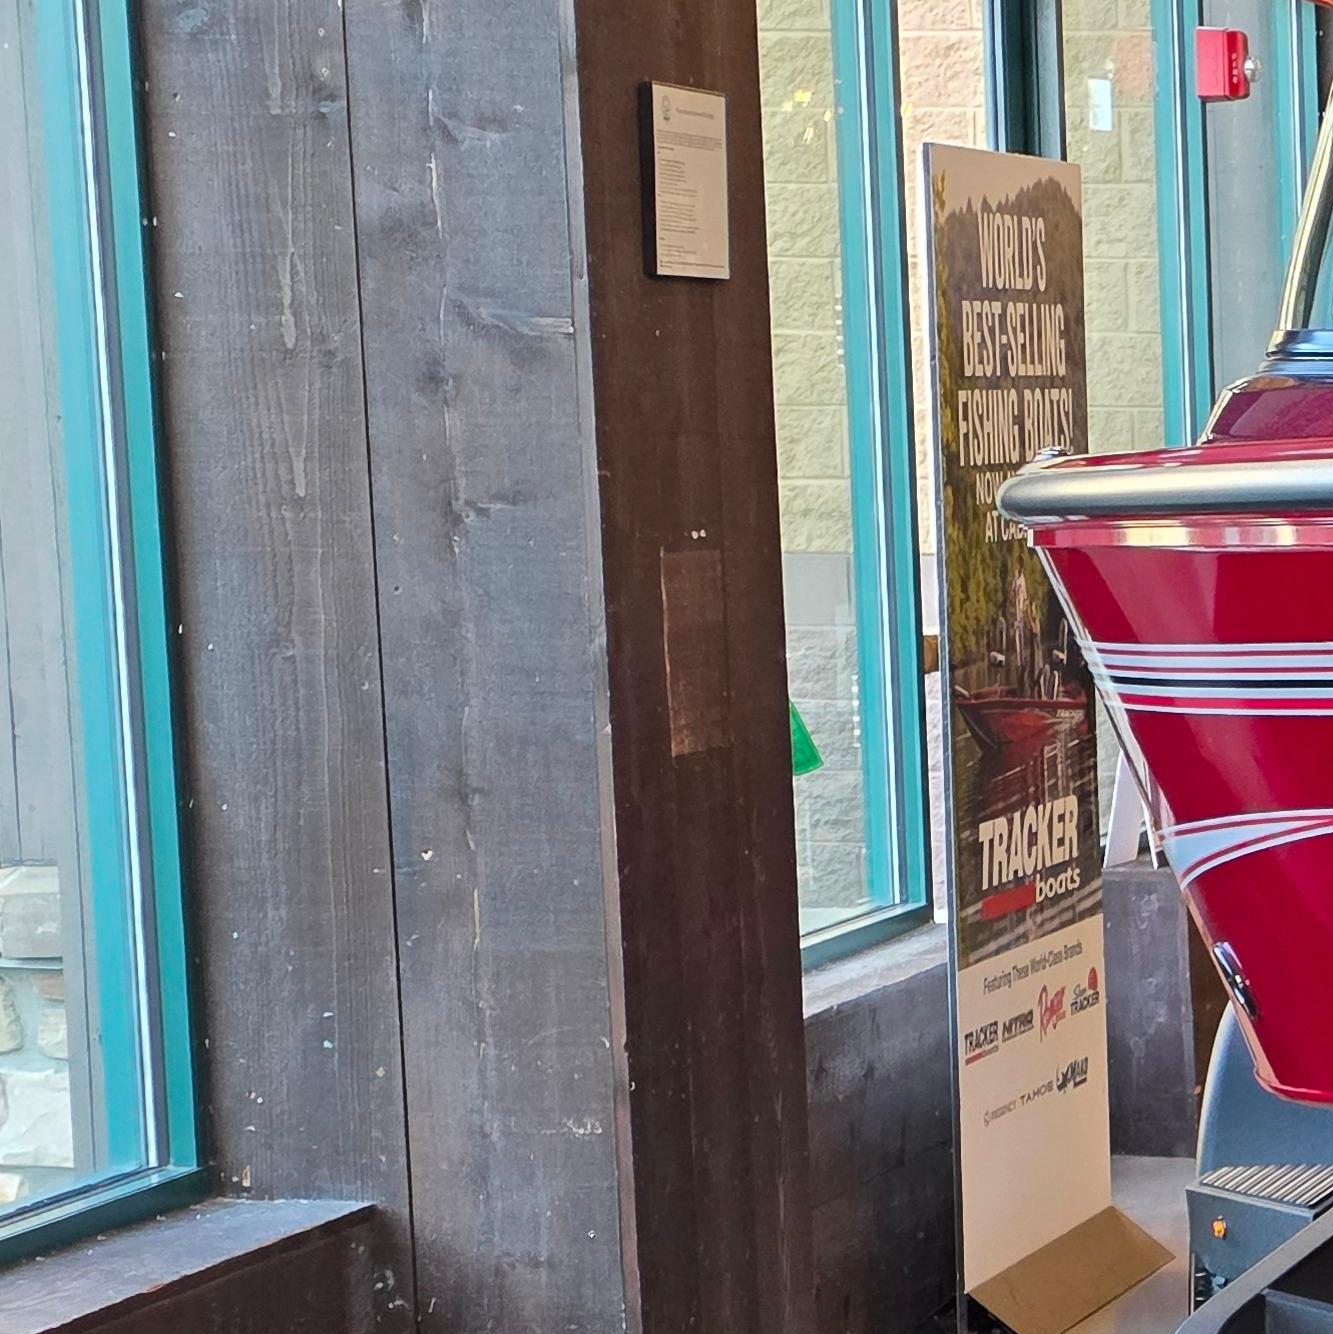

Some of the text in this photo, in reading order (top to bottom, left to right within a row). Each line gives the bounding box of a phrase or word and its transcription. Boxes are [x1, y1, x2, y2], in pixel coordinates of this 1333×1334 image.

[977, 211, 1047, 292] WORLD'S
[962, 300, 1067, 378] BEST-SELLING
[957, 387, 1020, 467] FISHING
[985, 510, 999, 543] AT
[978, 795, 1079, 891] TRACKER
[1035, 867, 1081, 903] boats
[964, 1020, 998, 1056] TRACKER
[1019, 1080, 1054, 1106] TAHOE
